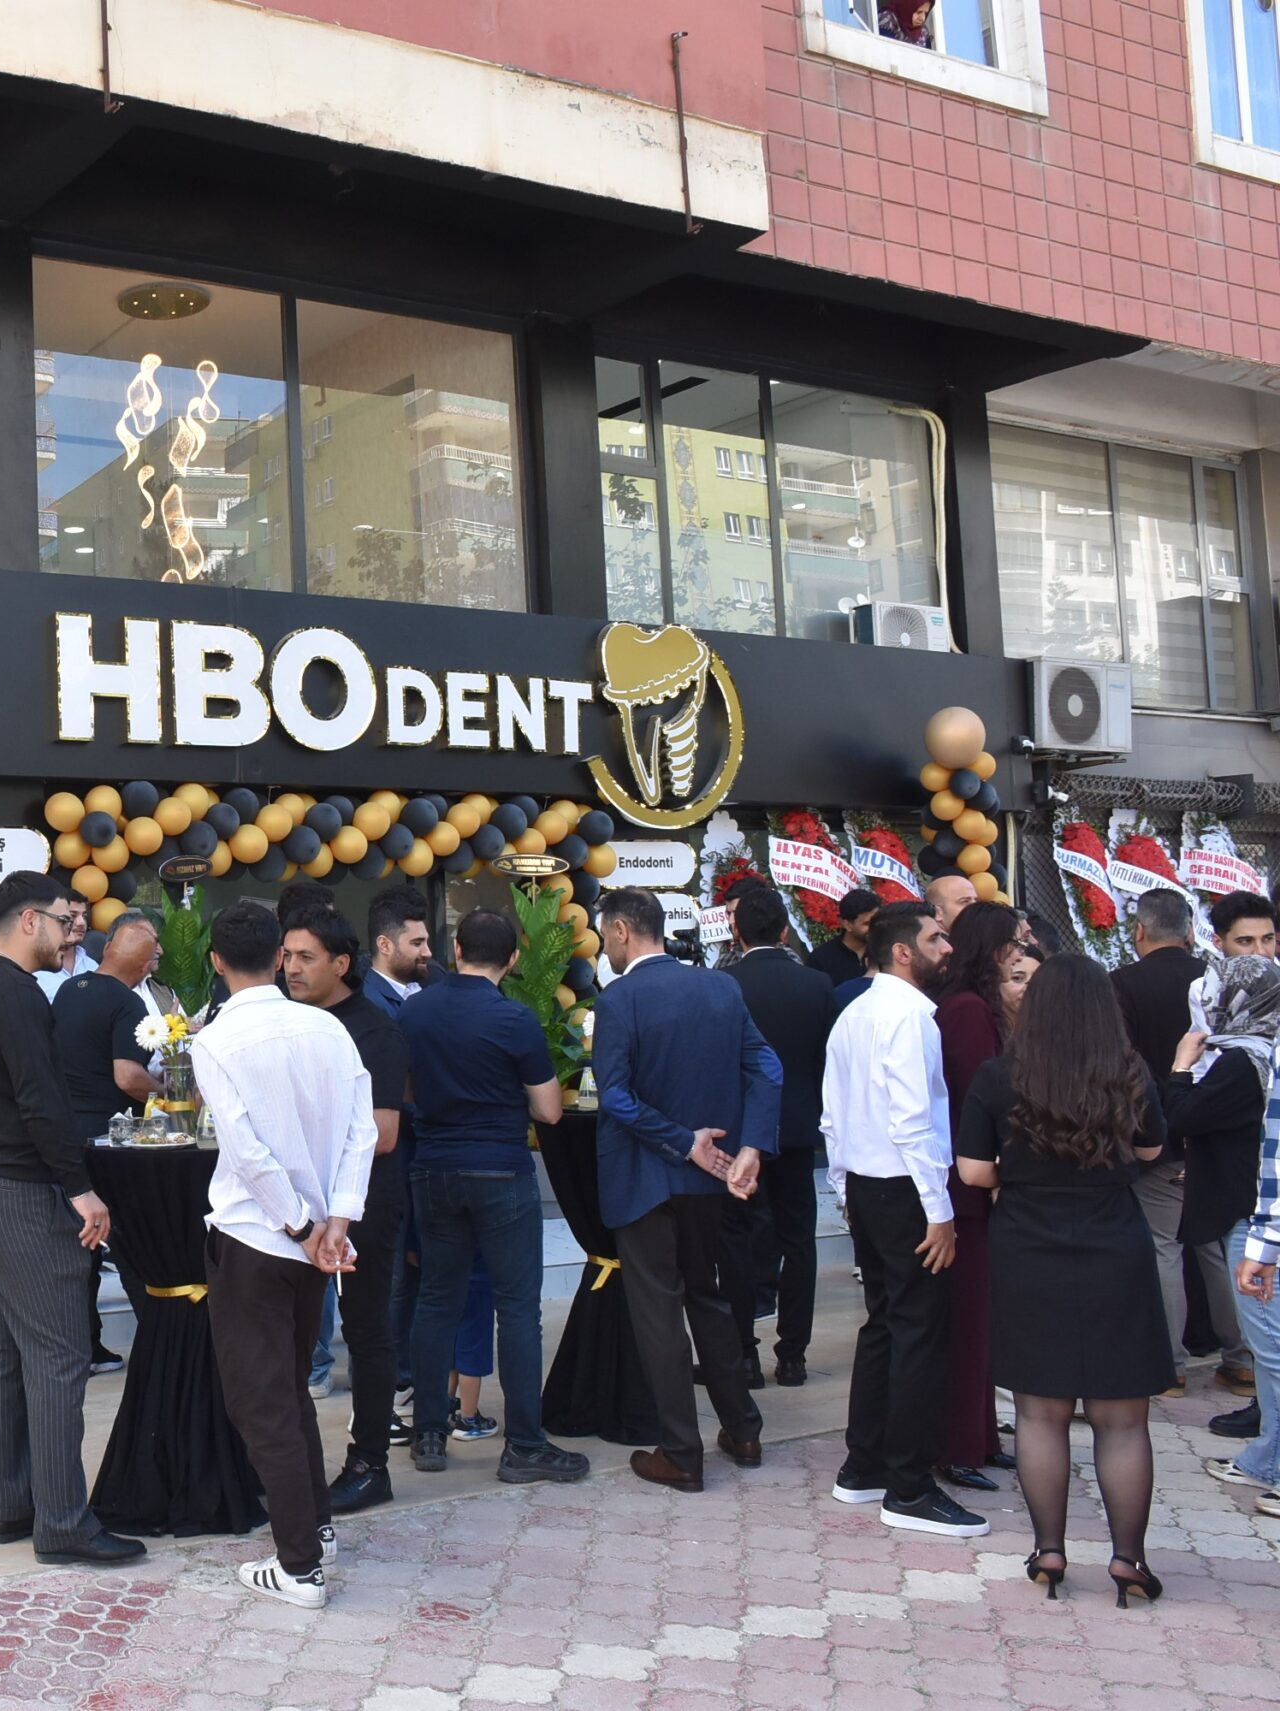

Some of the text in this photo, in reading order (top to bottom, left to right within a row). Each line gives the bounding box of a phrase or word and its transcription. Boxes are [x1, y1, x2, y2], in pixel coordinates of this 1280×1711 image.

[54, 611, 593, 756] HBO DENT
[618, 856, 674, 869] Endodonti
[853, 847, 916, 888] MUTLU
